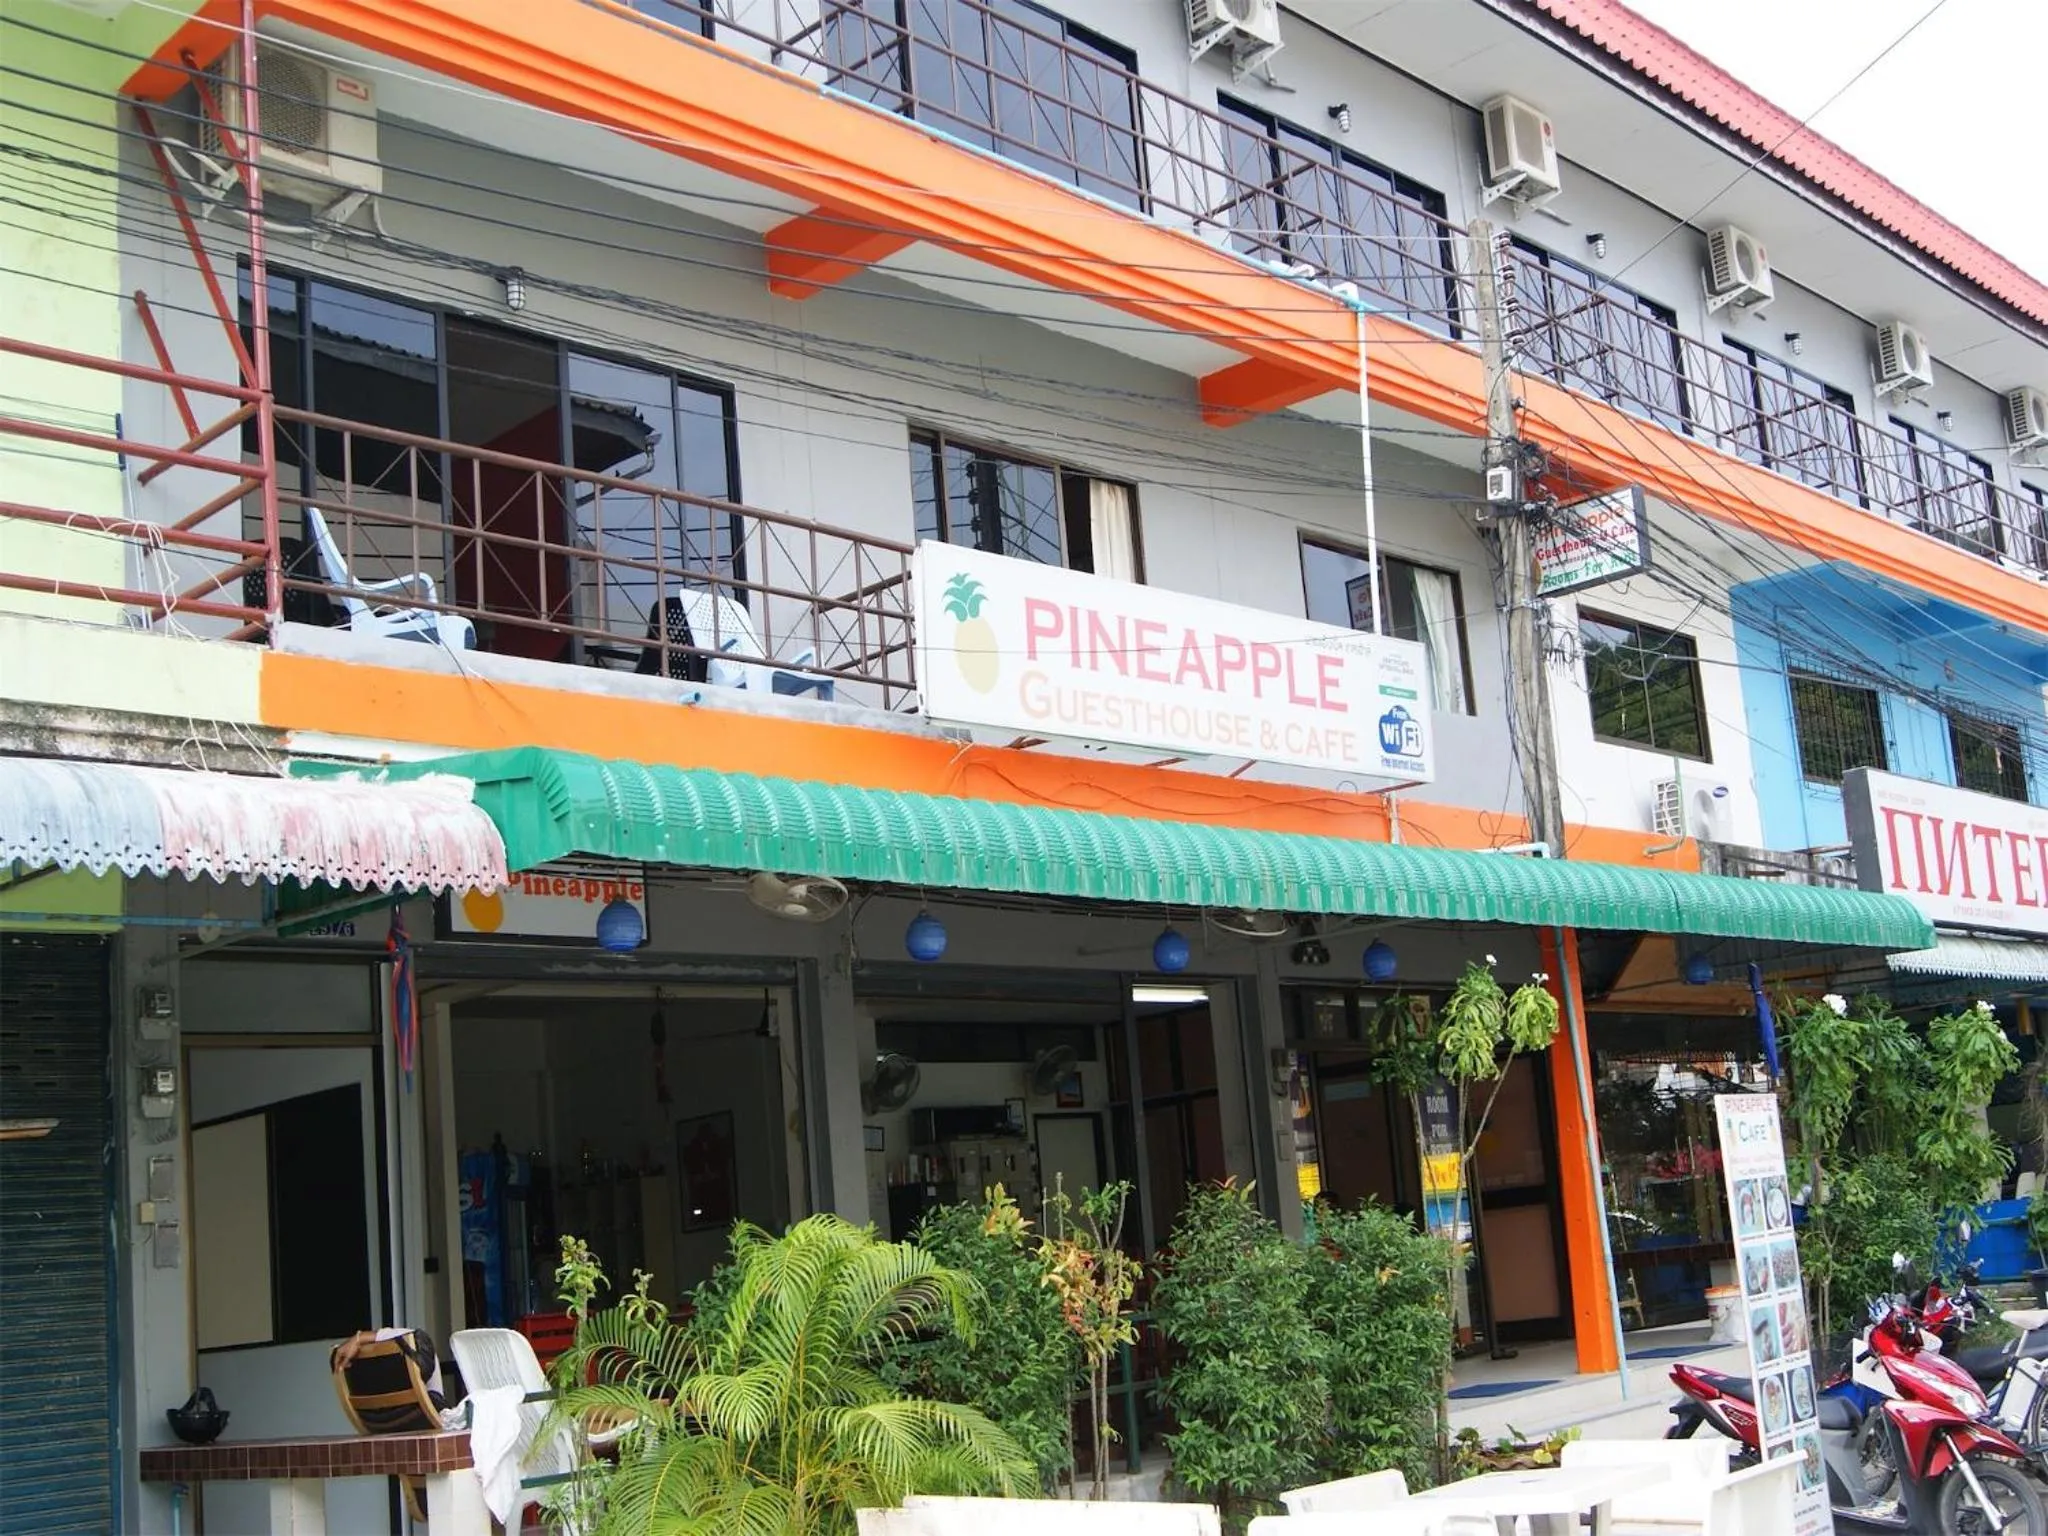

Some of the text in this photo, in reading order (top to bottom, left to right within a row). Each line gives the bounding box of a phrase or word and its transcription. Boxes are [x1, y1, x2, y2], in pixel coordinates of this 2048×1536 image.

[1024, 597, 1349, 713] PINEAPPLE
[1019, 669, 1360, 763] GUESTHOUSE & CAFE
